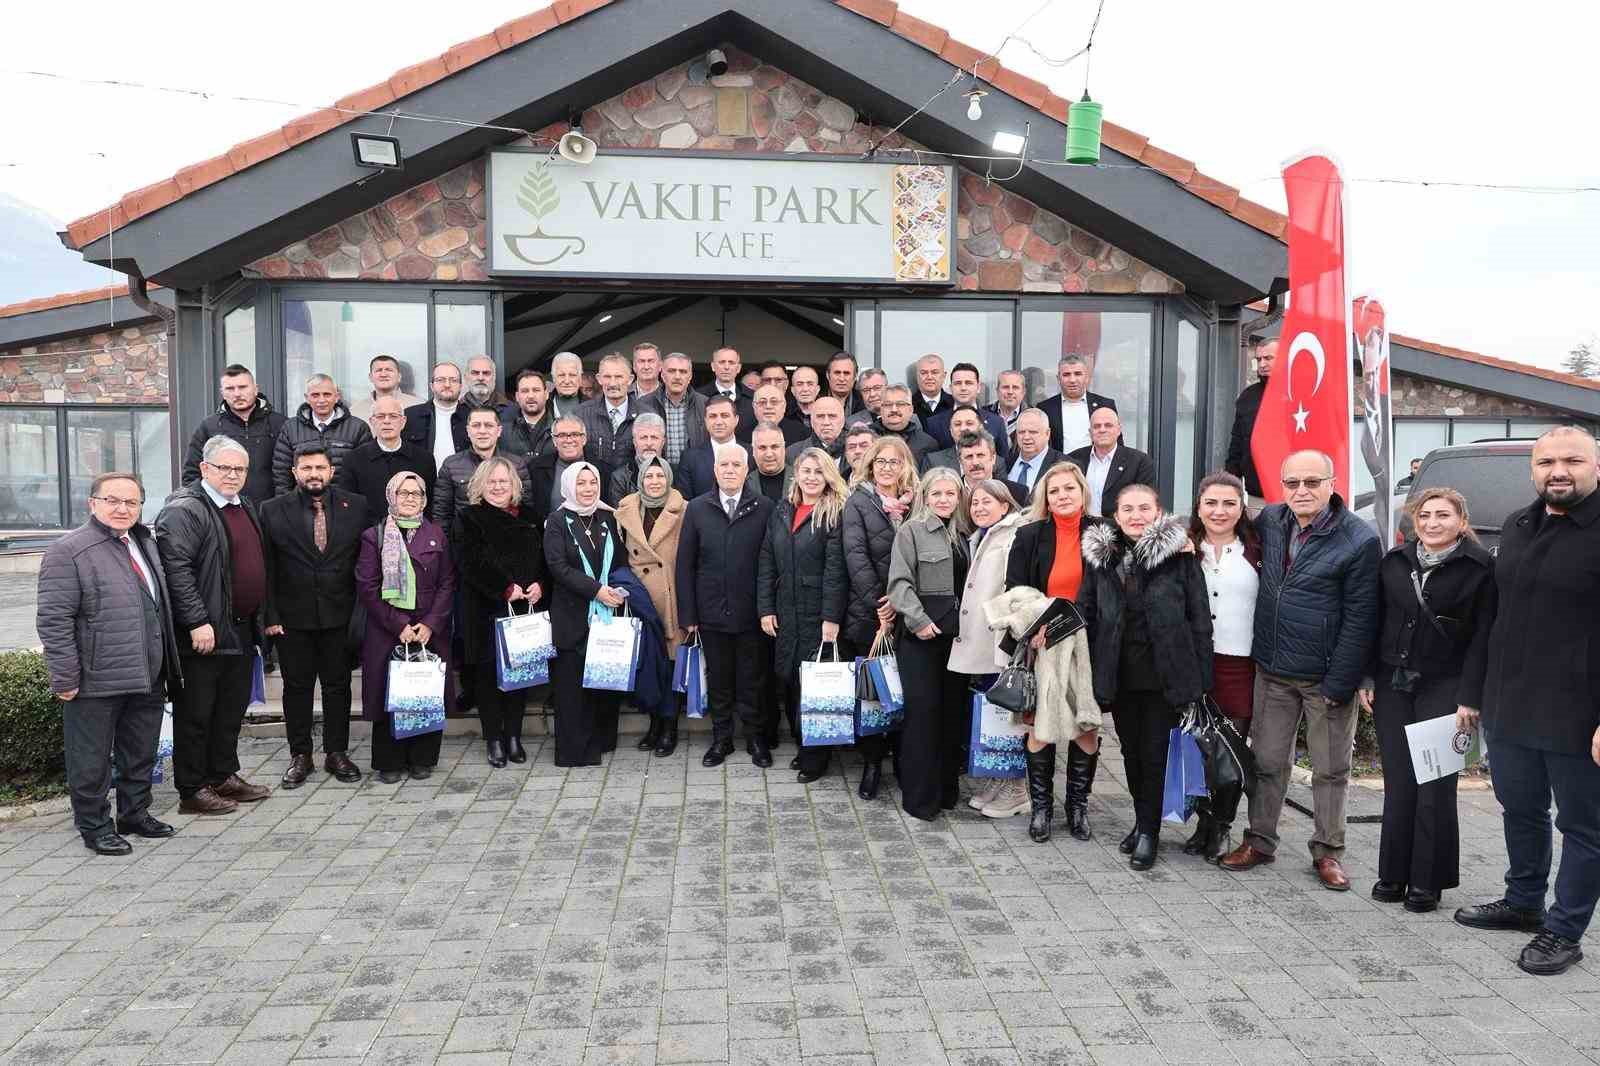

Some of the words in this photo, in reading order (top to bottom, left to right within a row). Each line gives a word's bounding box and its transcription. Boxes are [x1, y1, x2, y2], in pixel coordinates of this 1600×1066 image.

[581, 180, 733, 222] VAKIF
[751, 184, 885, 226] PARK
[695, 231, 774, 259] KAFE
